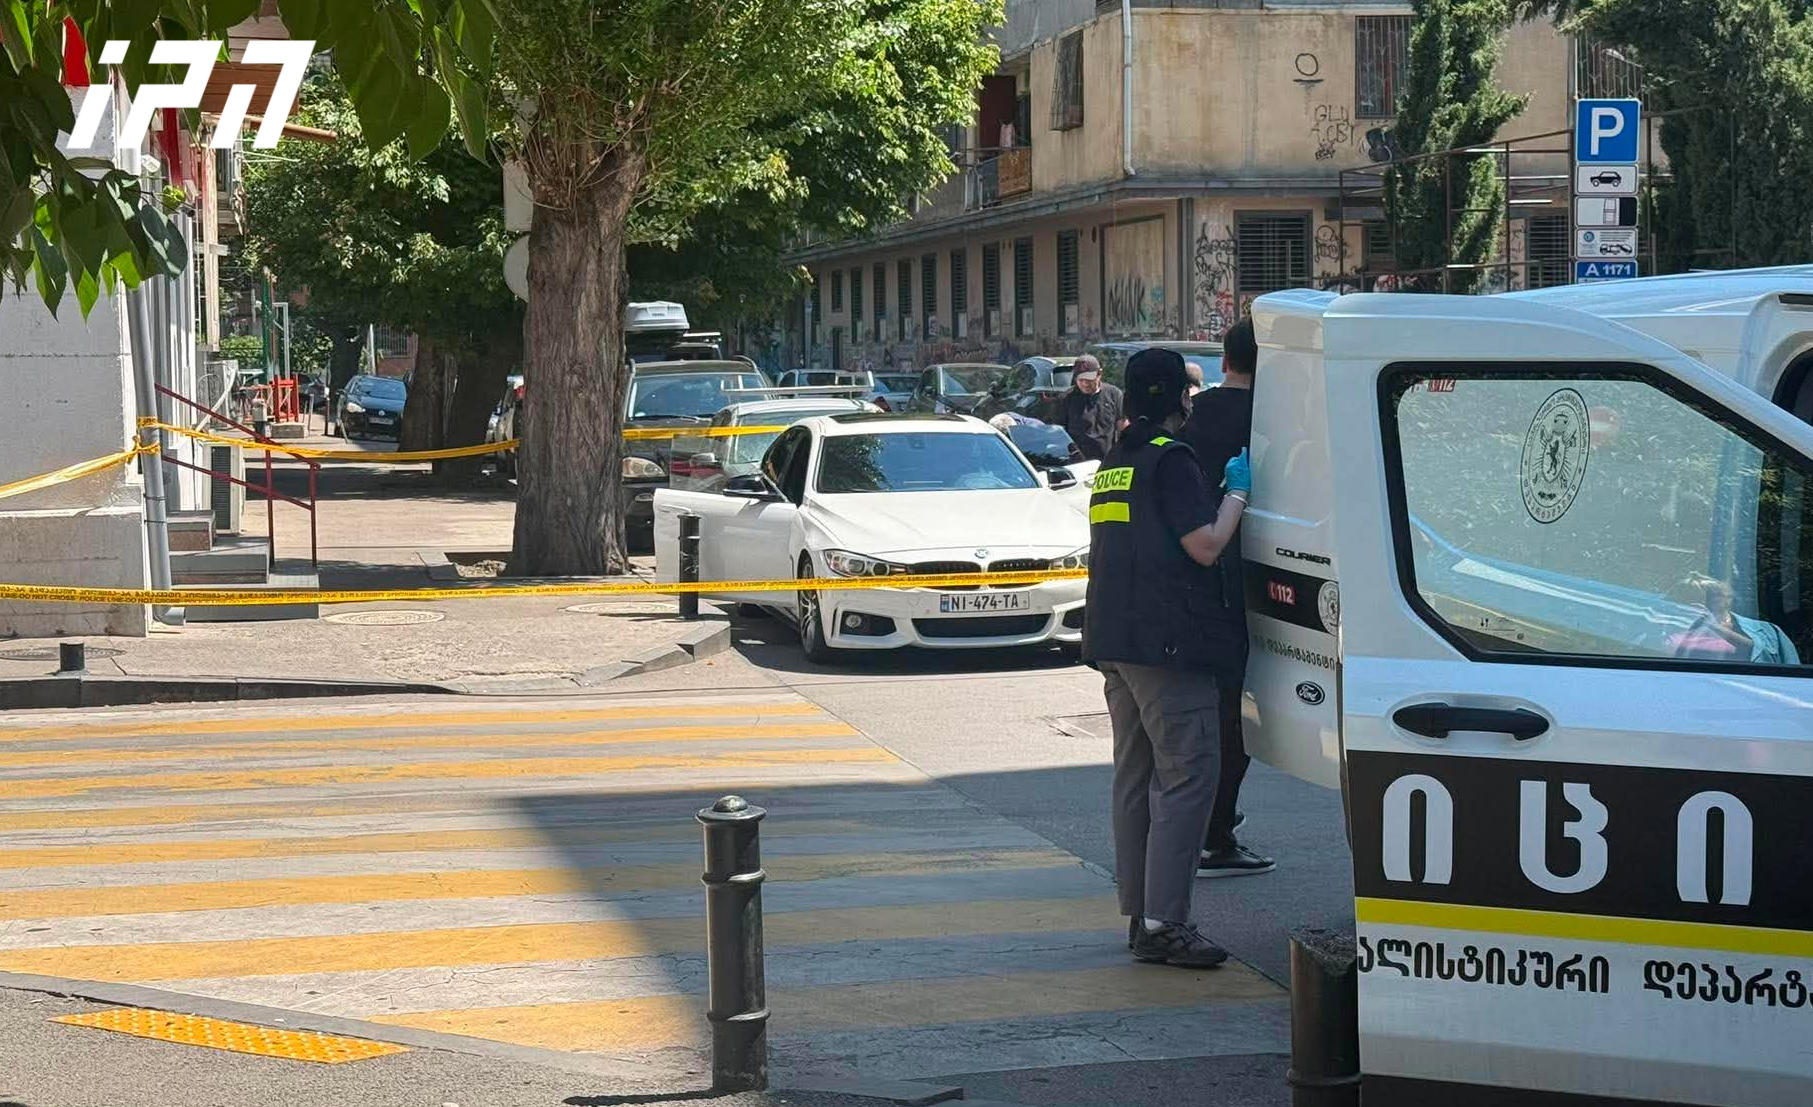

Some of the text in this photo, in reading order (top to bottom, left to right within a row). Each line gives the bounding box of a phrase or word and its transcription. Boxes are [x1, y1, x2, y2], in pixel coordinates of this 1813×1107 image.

[1590, 107, 1624, 155] P
[1585, 263, 1631, 276] A 1171
[1275, 547, 1331, 566] COURIER
[951, 593, 1019, 610] NI-474-TA
[1277, 584, 1296, 605] 112
[1357, 936, 1813, 1009] ალისტიკური დეპარტ
